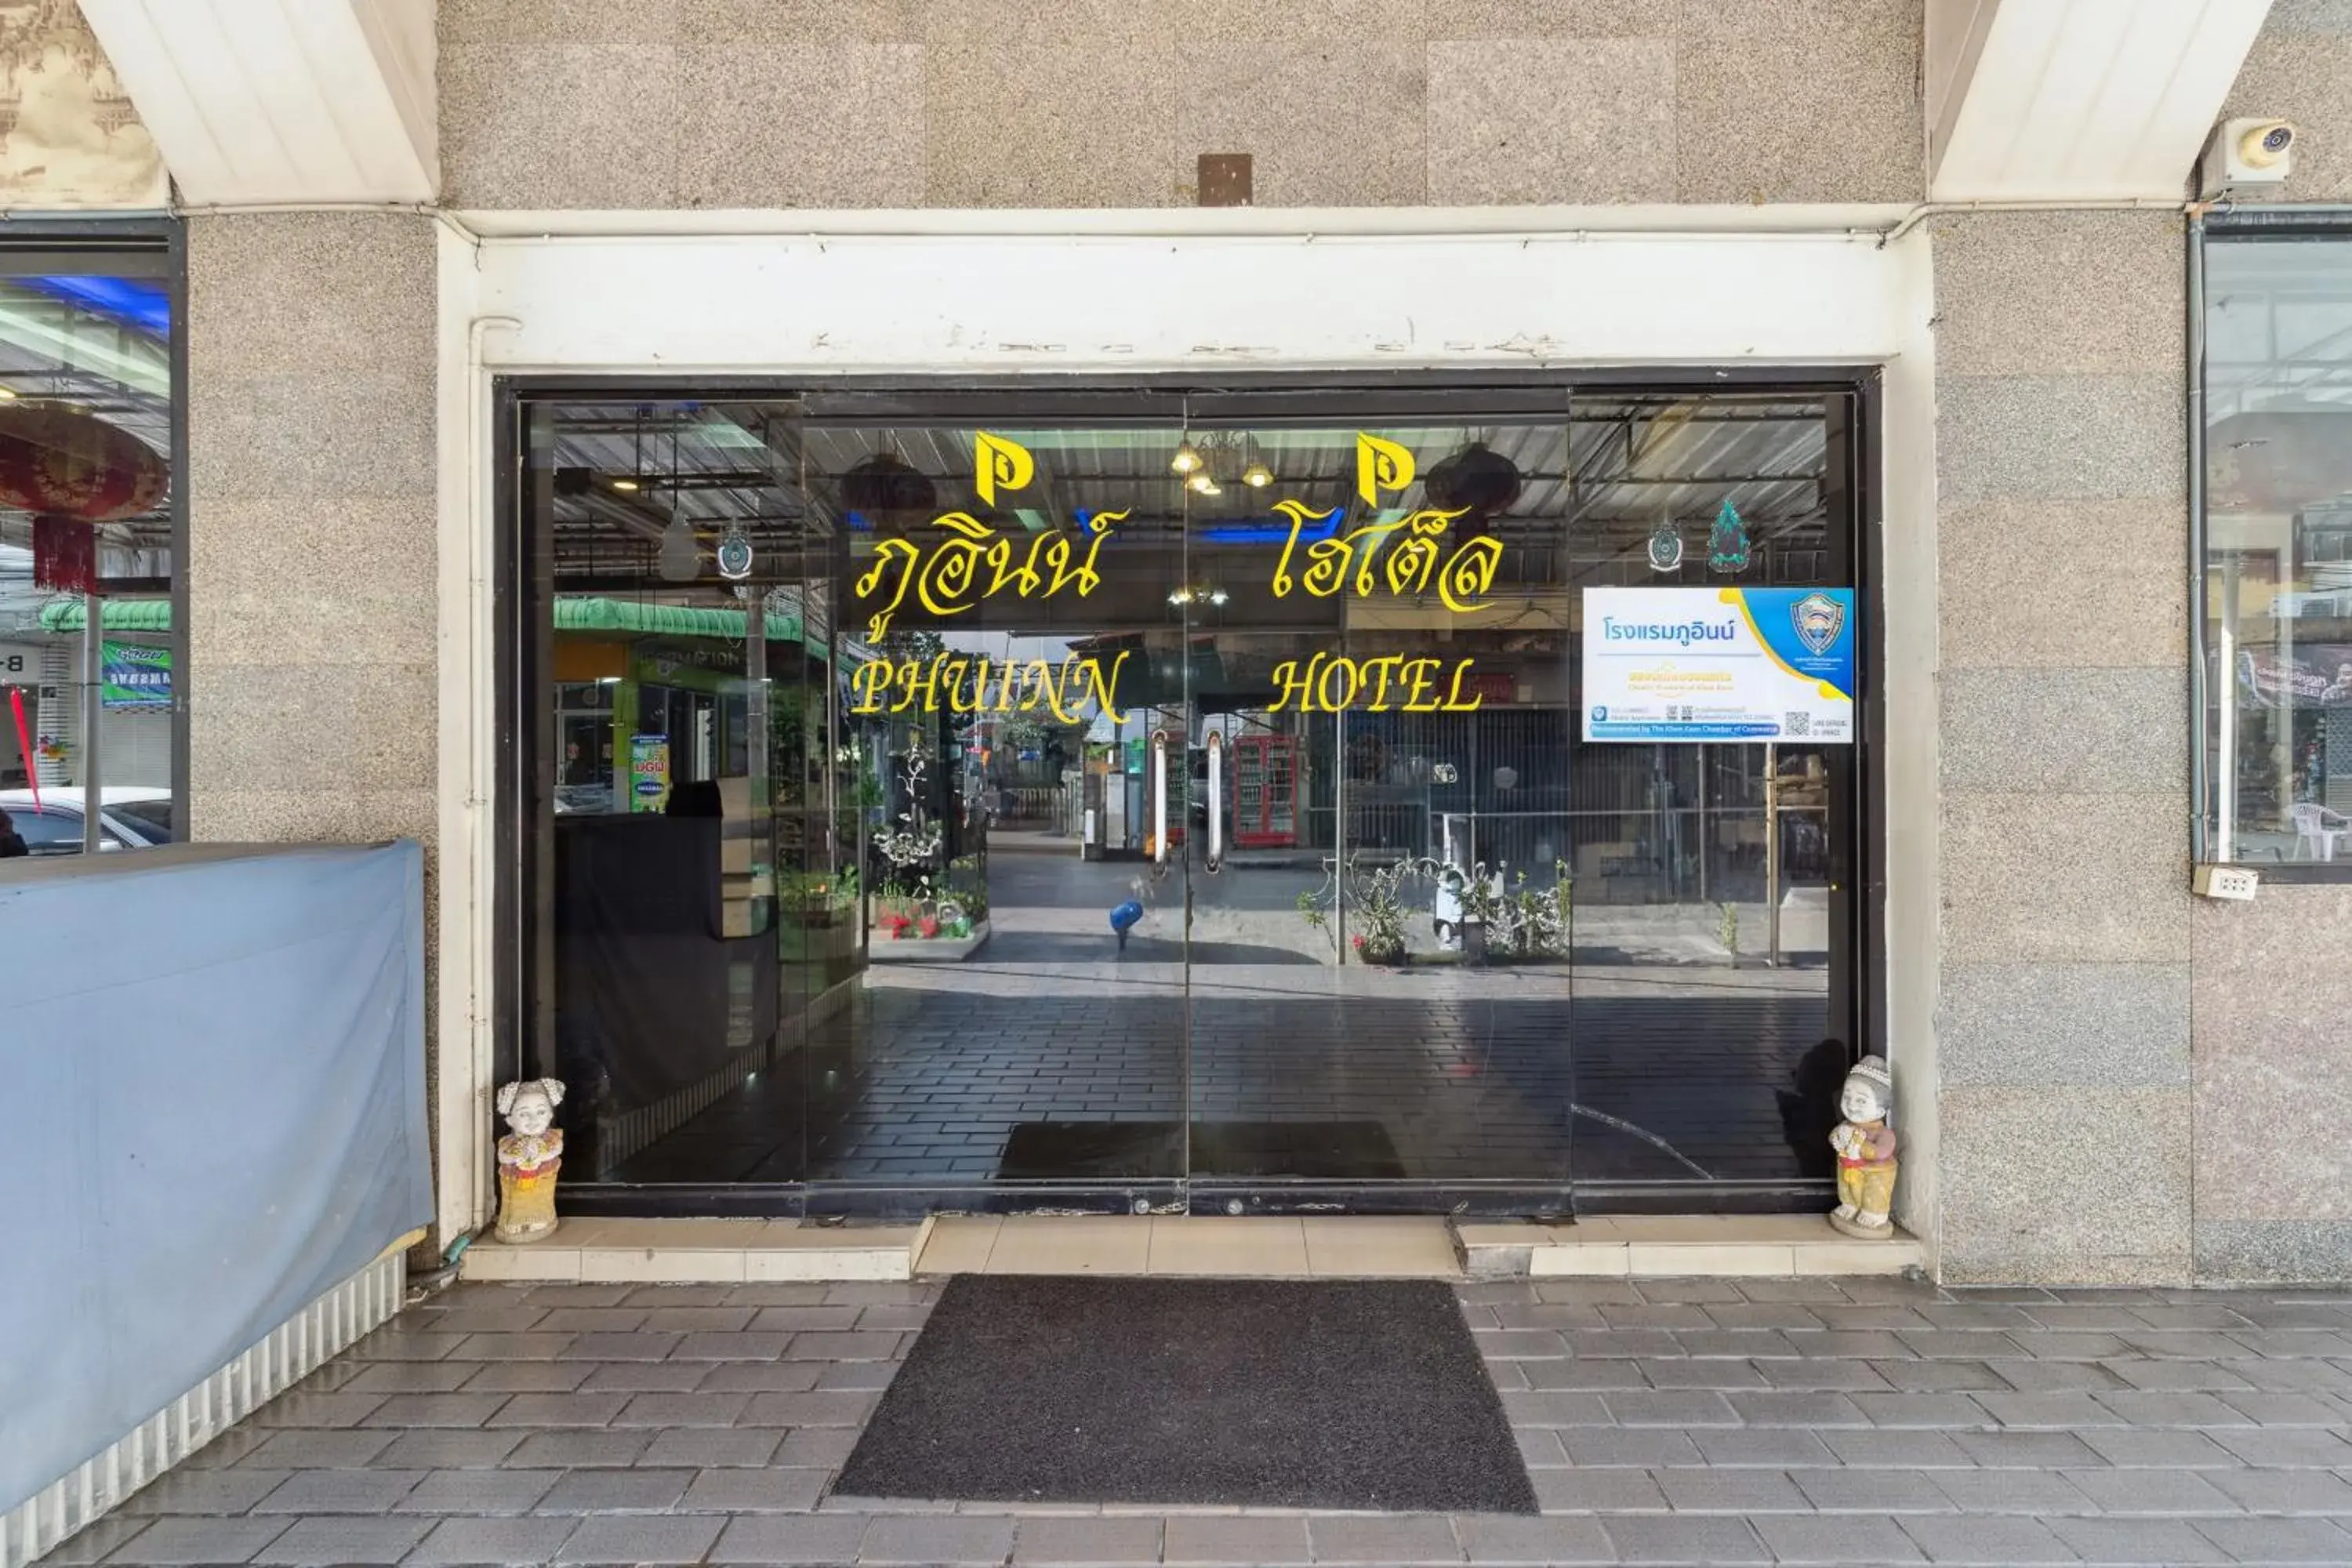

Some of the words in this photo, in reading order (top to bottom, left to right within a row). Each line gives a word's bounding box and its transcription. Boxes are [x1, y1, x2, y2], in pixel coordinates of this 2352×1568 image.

[855, 506, 1131, 644] ภูอินน์
[1272, 499, 1504, 613] โฮเต็ล
[1604, 617, 1736, 647] โรงแรมภูอินน์
[852, 652, 1131, 724] PHUINN
[1267, 652, 1481, 713] HOTEL
